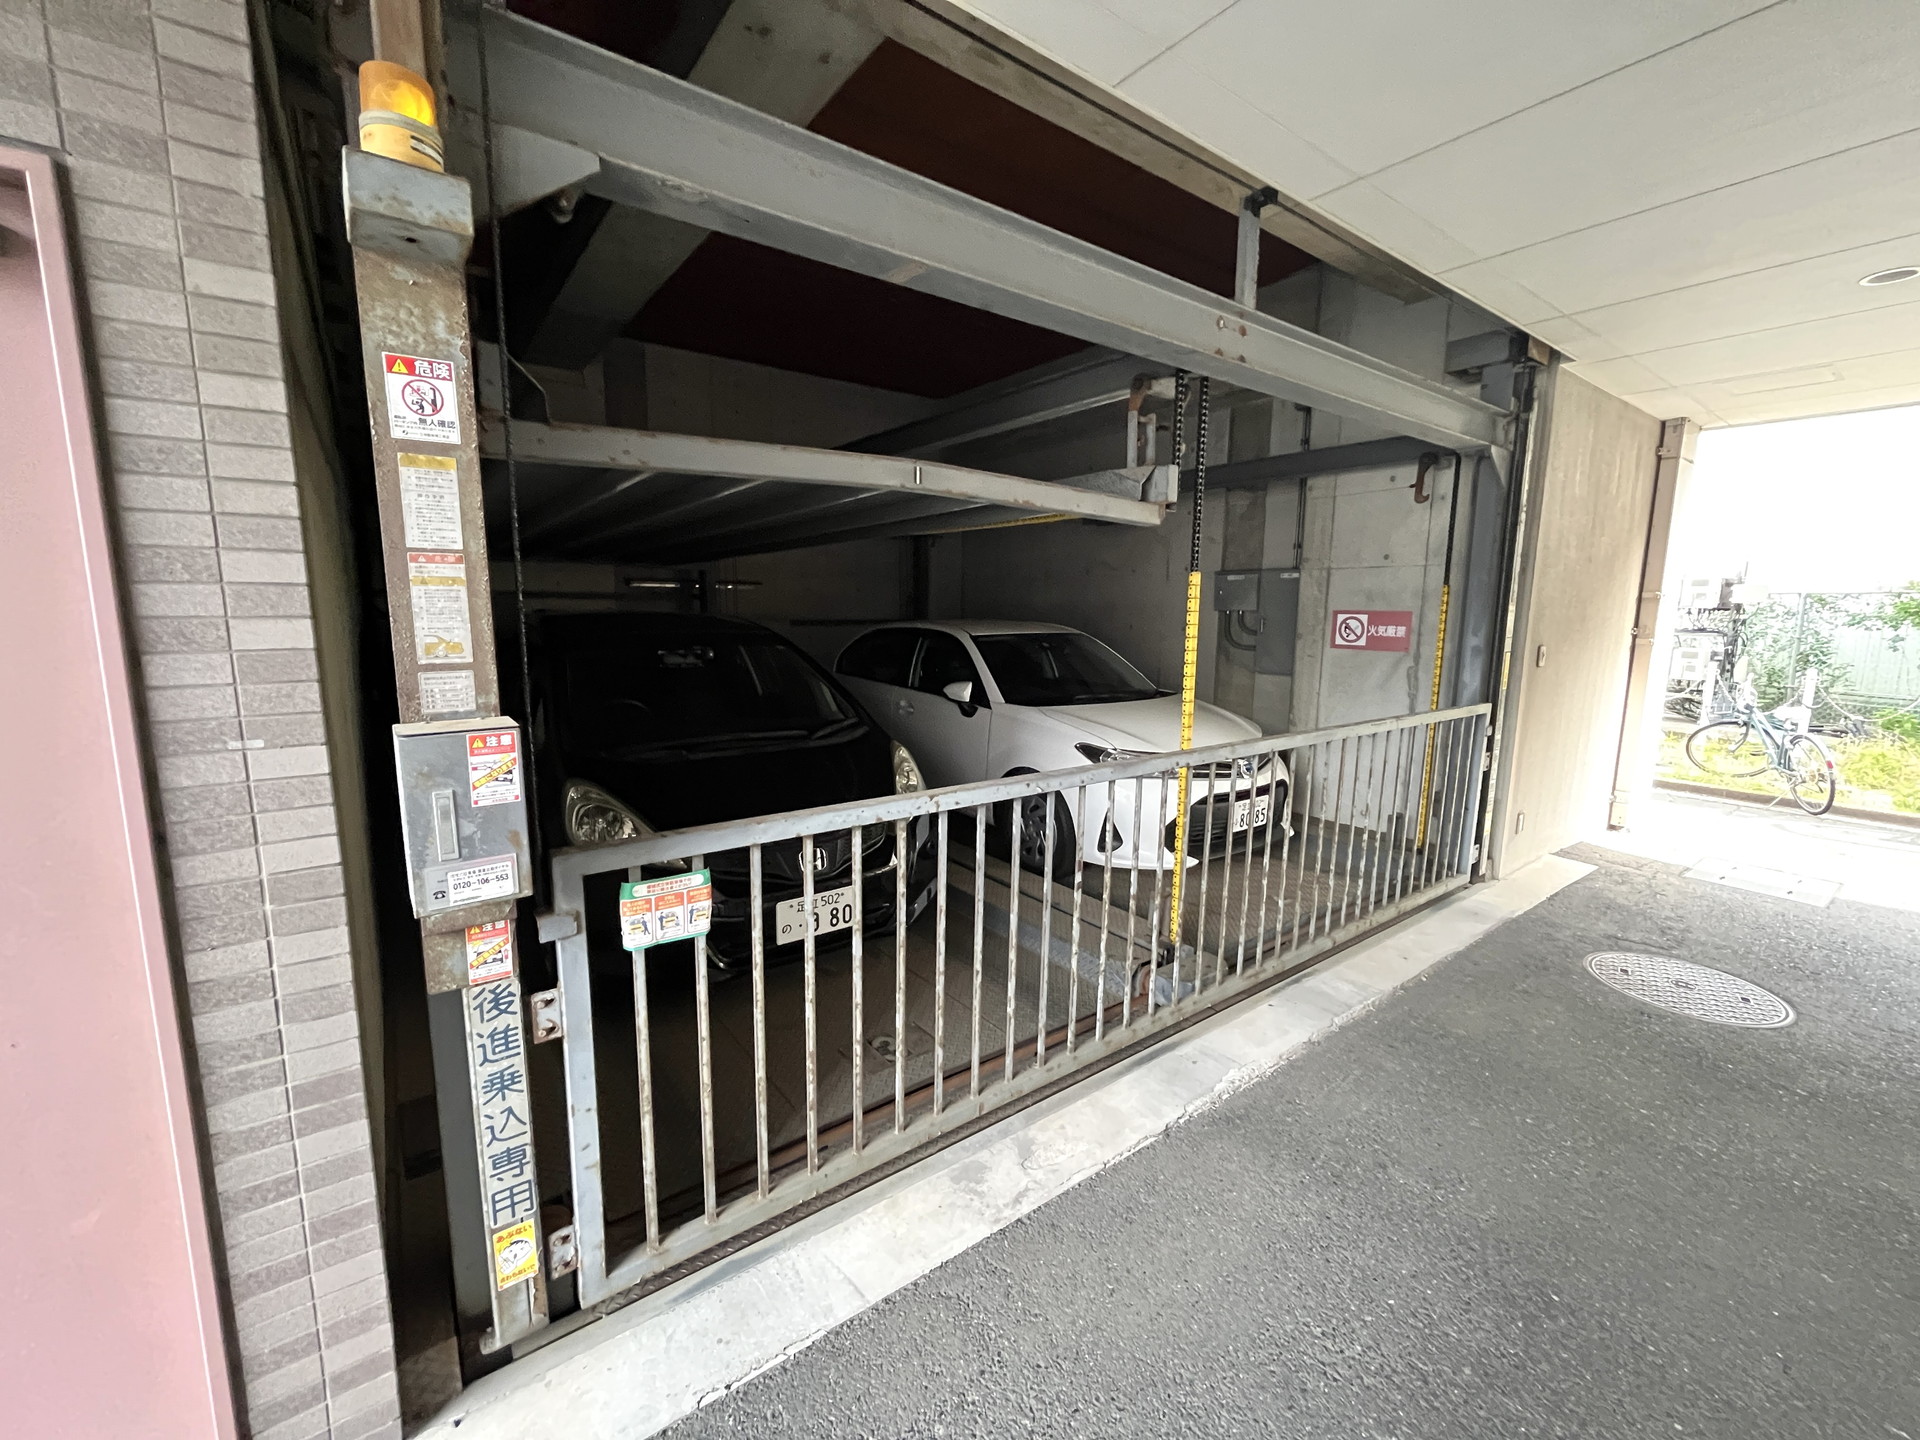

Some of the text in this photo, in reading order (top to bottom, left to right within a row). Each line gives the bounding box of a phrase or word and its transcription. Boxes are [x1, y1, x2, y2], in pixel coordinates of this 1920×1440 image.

[413, 359, 451, 379] 危険
[418, 417, 456, 430] 無人確認
[1367, 624, 1407, 638] 火気厳禁
[486, 734, 512, 747] 注意
[453, 873, 509, 891] 0120-106-553
[820, 892, 840, 907] 502
[482, 920, 506, 932] 注意
[782, 924, 792, 934] の
[829, 903, 852, 927] 80
[471, 982, 537, 1228] 後進乗込専用
[496, 1224, 533, 1244] あぶない
